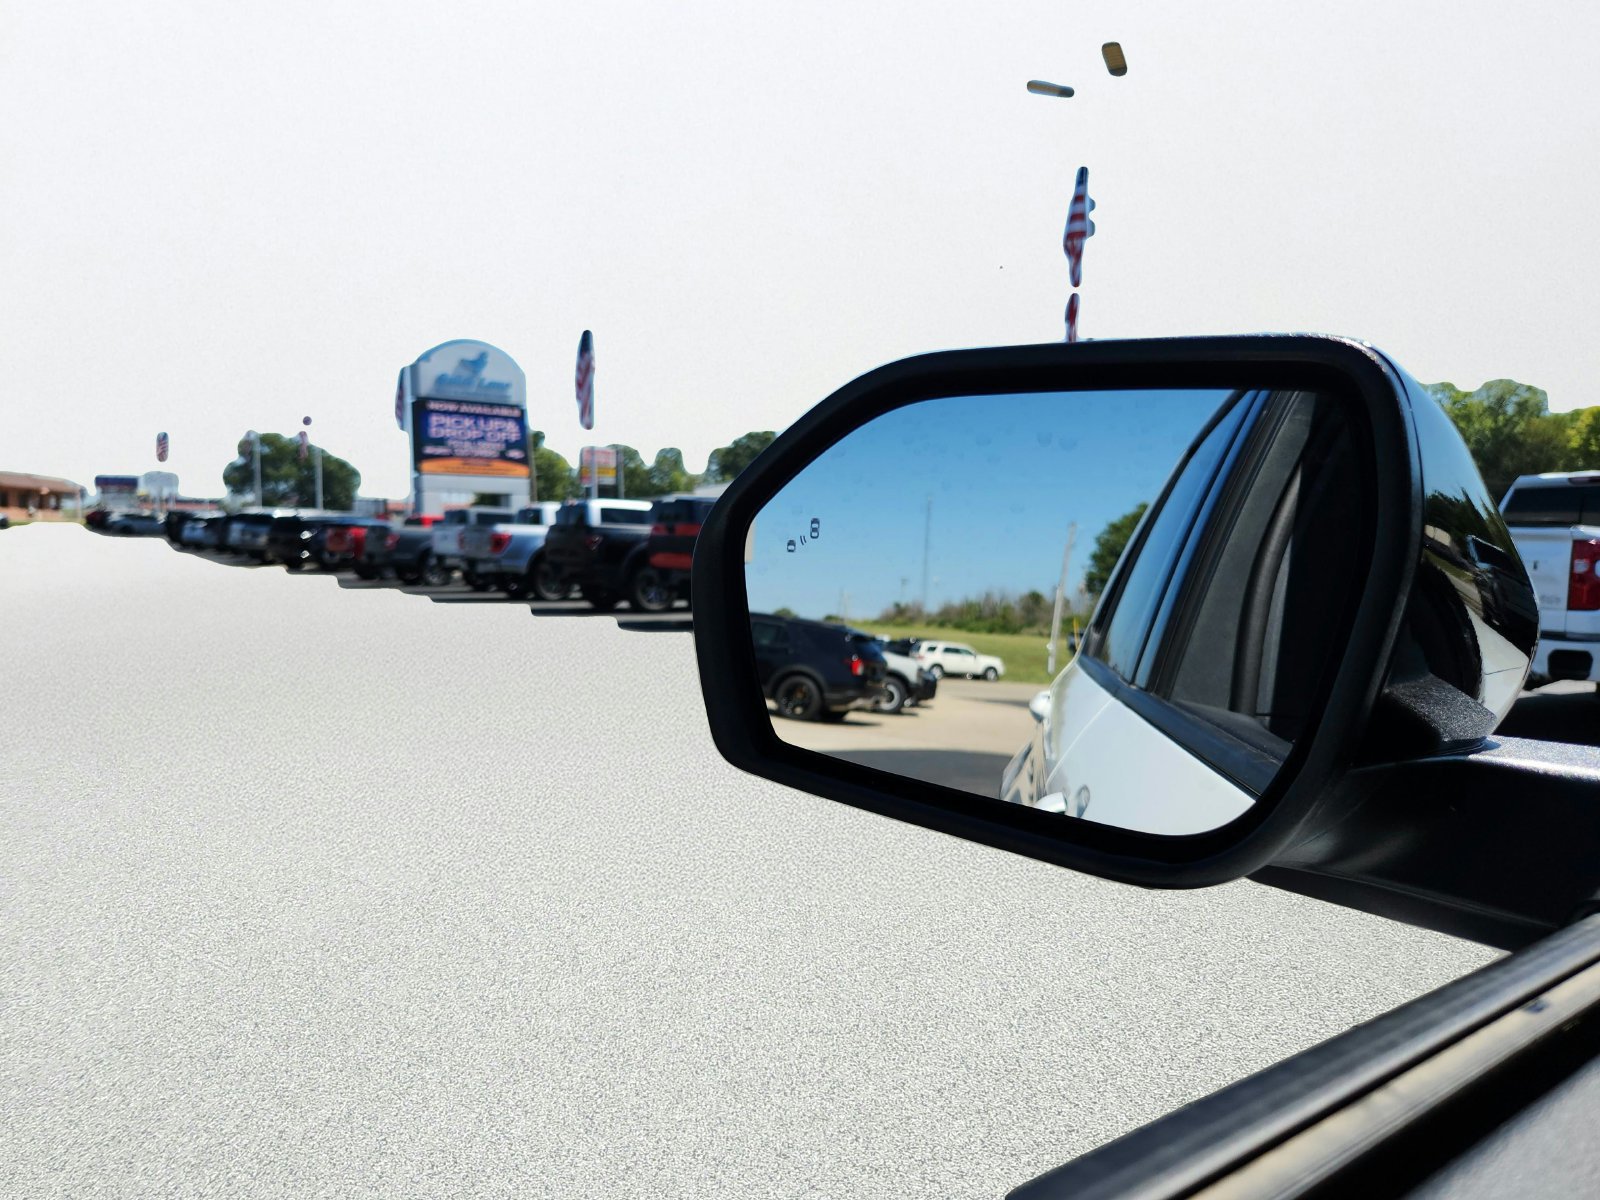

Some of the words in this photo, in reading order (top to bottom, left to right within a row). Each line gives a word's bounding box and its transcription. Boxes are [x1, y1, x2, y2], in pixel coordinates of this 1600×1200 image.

[427, 401, 458, 412] NOW
[459, 404, 521, 417] AVAILABLE
[428, 414, 475, 429] PICK
[428, 428, 483, 440] DROP
[486, 431, 521, 443] OFF
